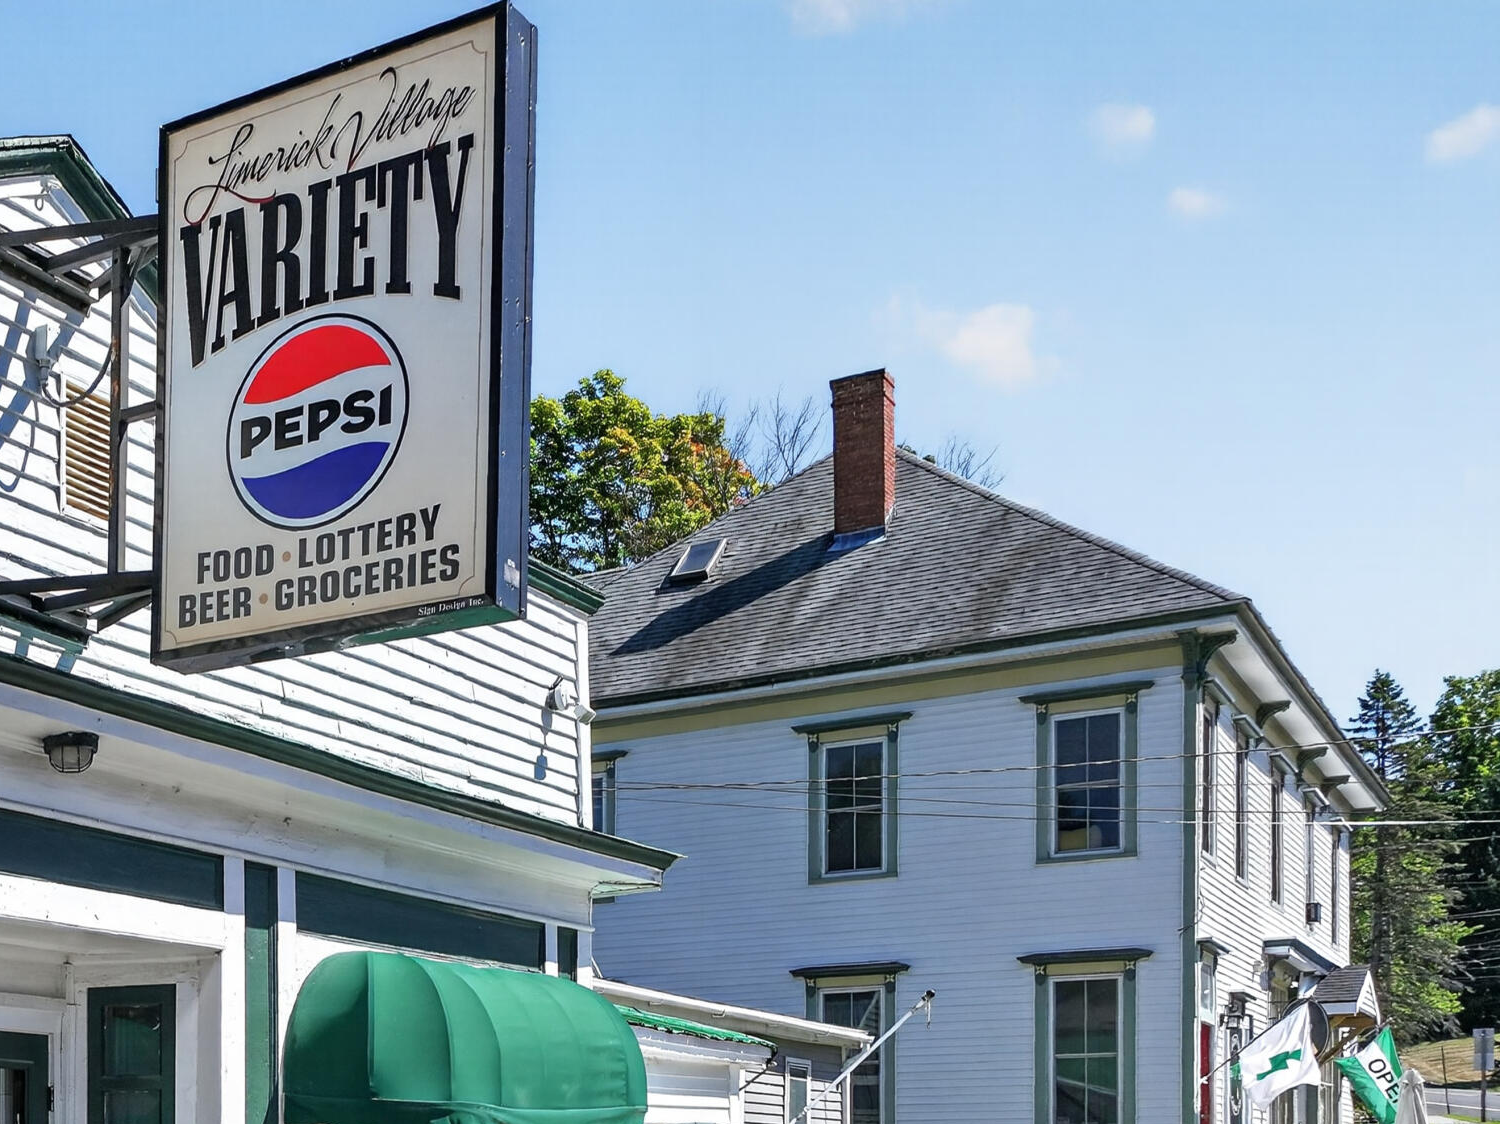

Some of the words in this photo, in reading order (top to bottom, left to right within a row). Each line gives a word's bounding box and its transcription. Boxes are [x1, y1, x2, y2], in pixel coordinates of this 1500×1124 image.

[184, 92, 341, 226] Limerick
[330, 66, 476, 175] Village
[180, 132, 475, 369] VARIETY
[240, 383, 393, 460] PEPSI
[197, 543, 274, 585] FOOD
[298, 502, 441, 569] LOTTERY
[178, 586, 252, 629] BEER
[274, 543, 460, 612] GROCERIES
[1368, 1058, 1400, 1104] OPE
